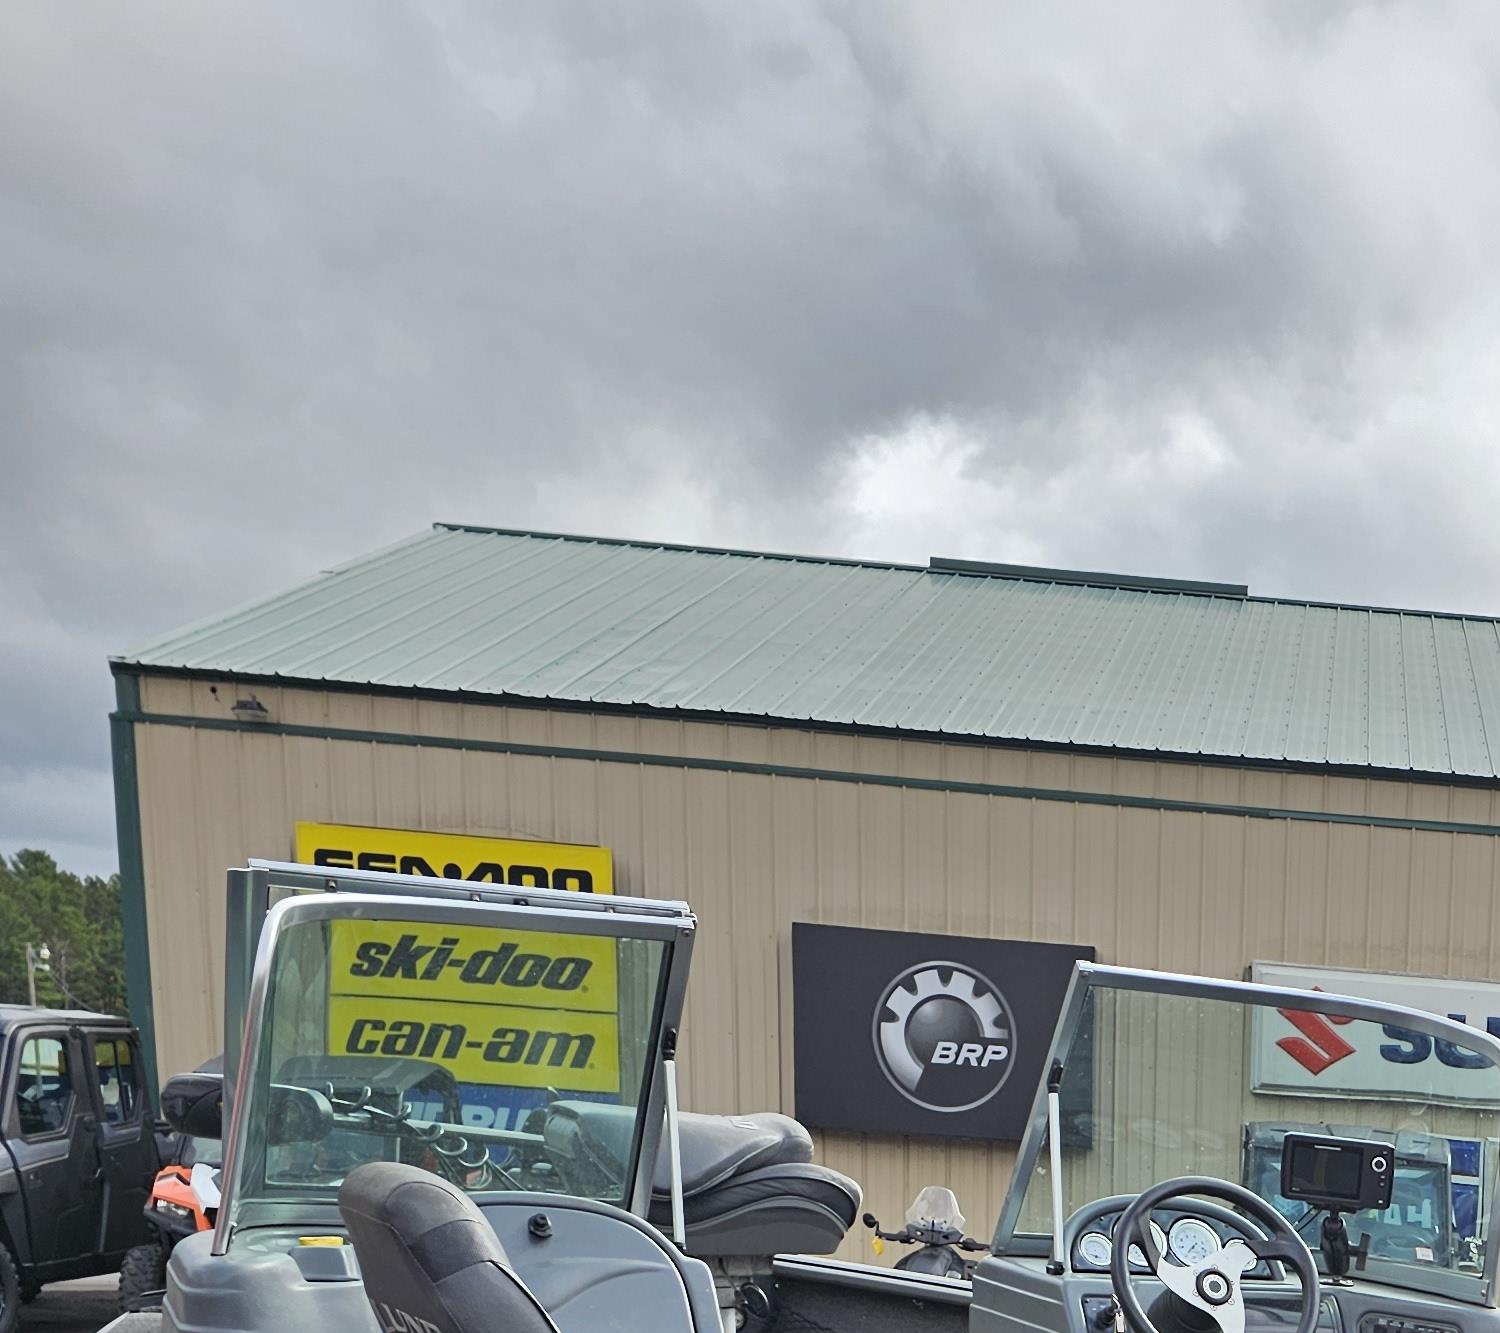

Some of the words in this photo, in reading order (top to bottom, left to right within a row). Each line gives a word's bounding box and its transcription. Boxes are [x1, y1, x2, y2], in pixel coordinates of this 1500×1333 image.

[349, 934, 594, 992] ski-doo
[345, 1018, 596, 1069] can-am
[930, 1041, 1009, 1068] BRP
